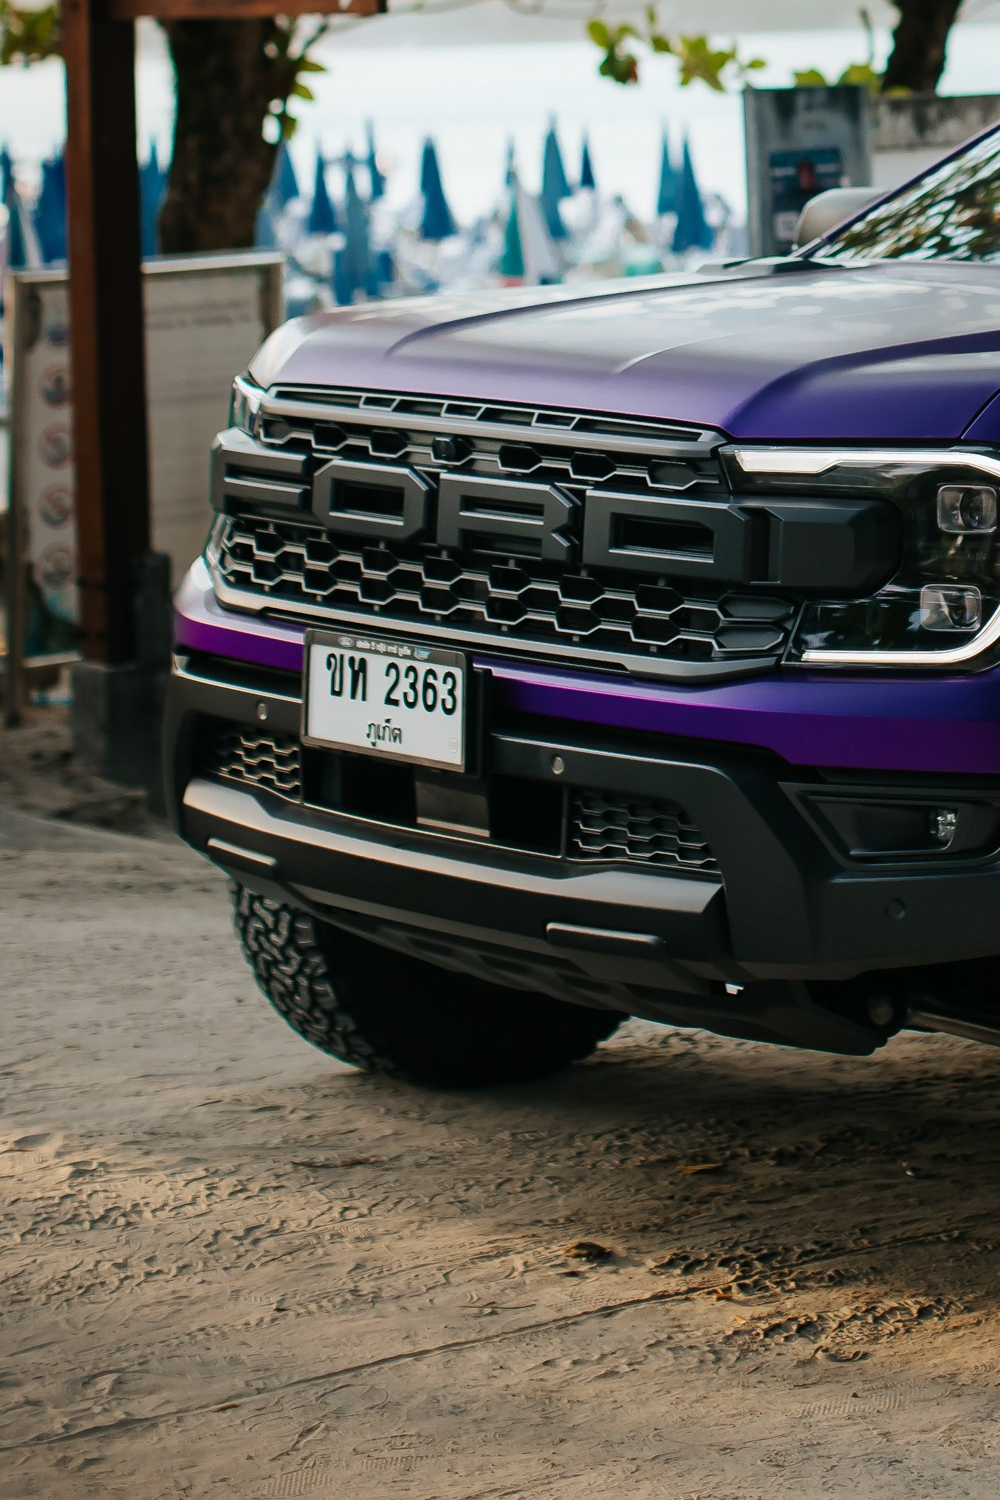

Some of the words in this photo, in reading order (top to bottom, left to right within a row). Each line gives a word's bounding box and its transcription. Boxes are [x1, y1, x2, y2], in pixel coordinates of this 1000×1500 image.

[210, 426, 751, 582] FORD
[325, 653, 367, 701] ขท
[384, 662, 457, 716] 2363
[366, 718, 402, 747] ภูเก็ต
